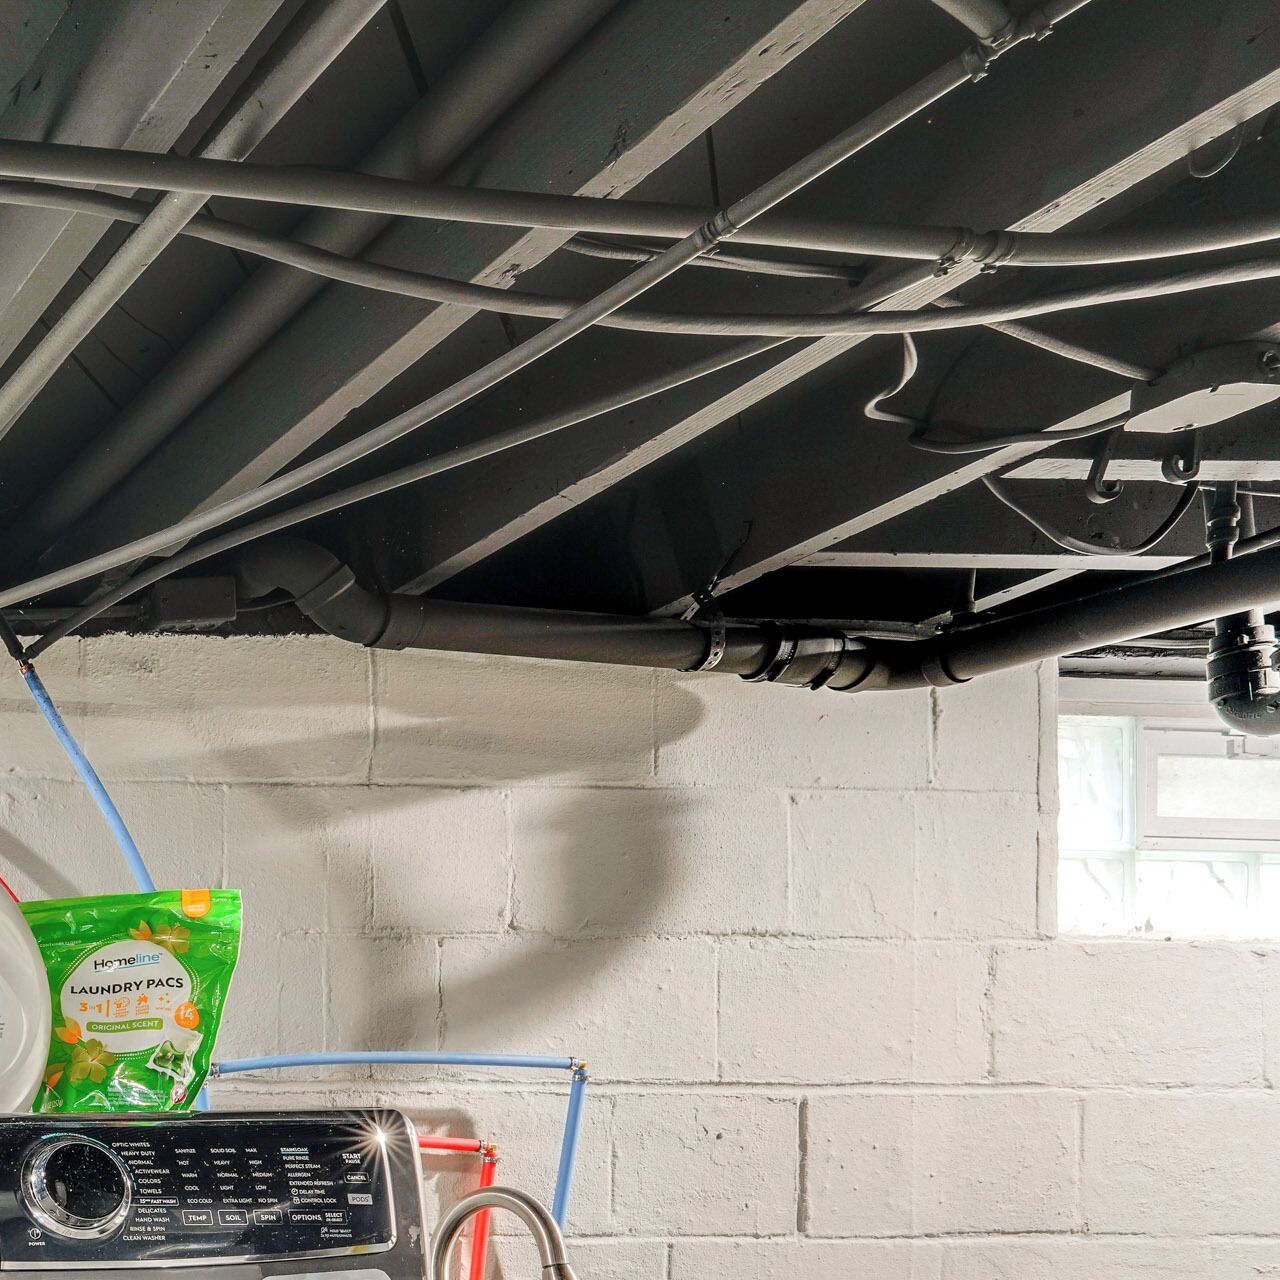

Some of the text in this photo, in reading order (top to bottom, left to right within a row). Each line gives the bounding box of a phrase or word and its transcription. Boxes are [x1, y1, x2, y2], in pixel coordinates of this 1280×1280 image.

[94, 953, 160, 970] Homeline
[70, 977, 184, 995] LAUNDRY PACS
[91, 1020, 159, 1031] ORIGINAL SCENT
